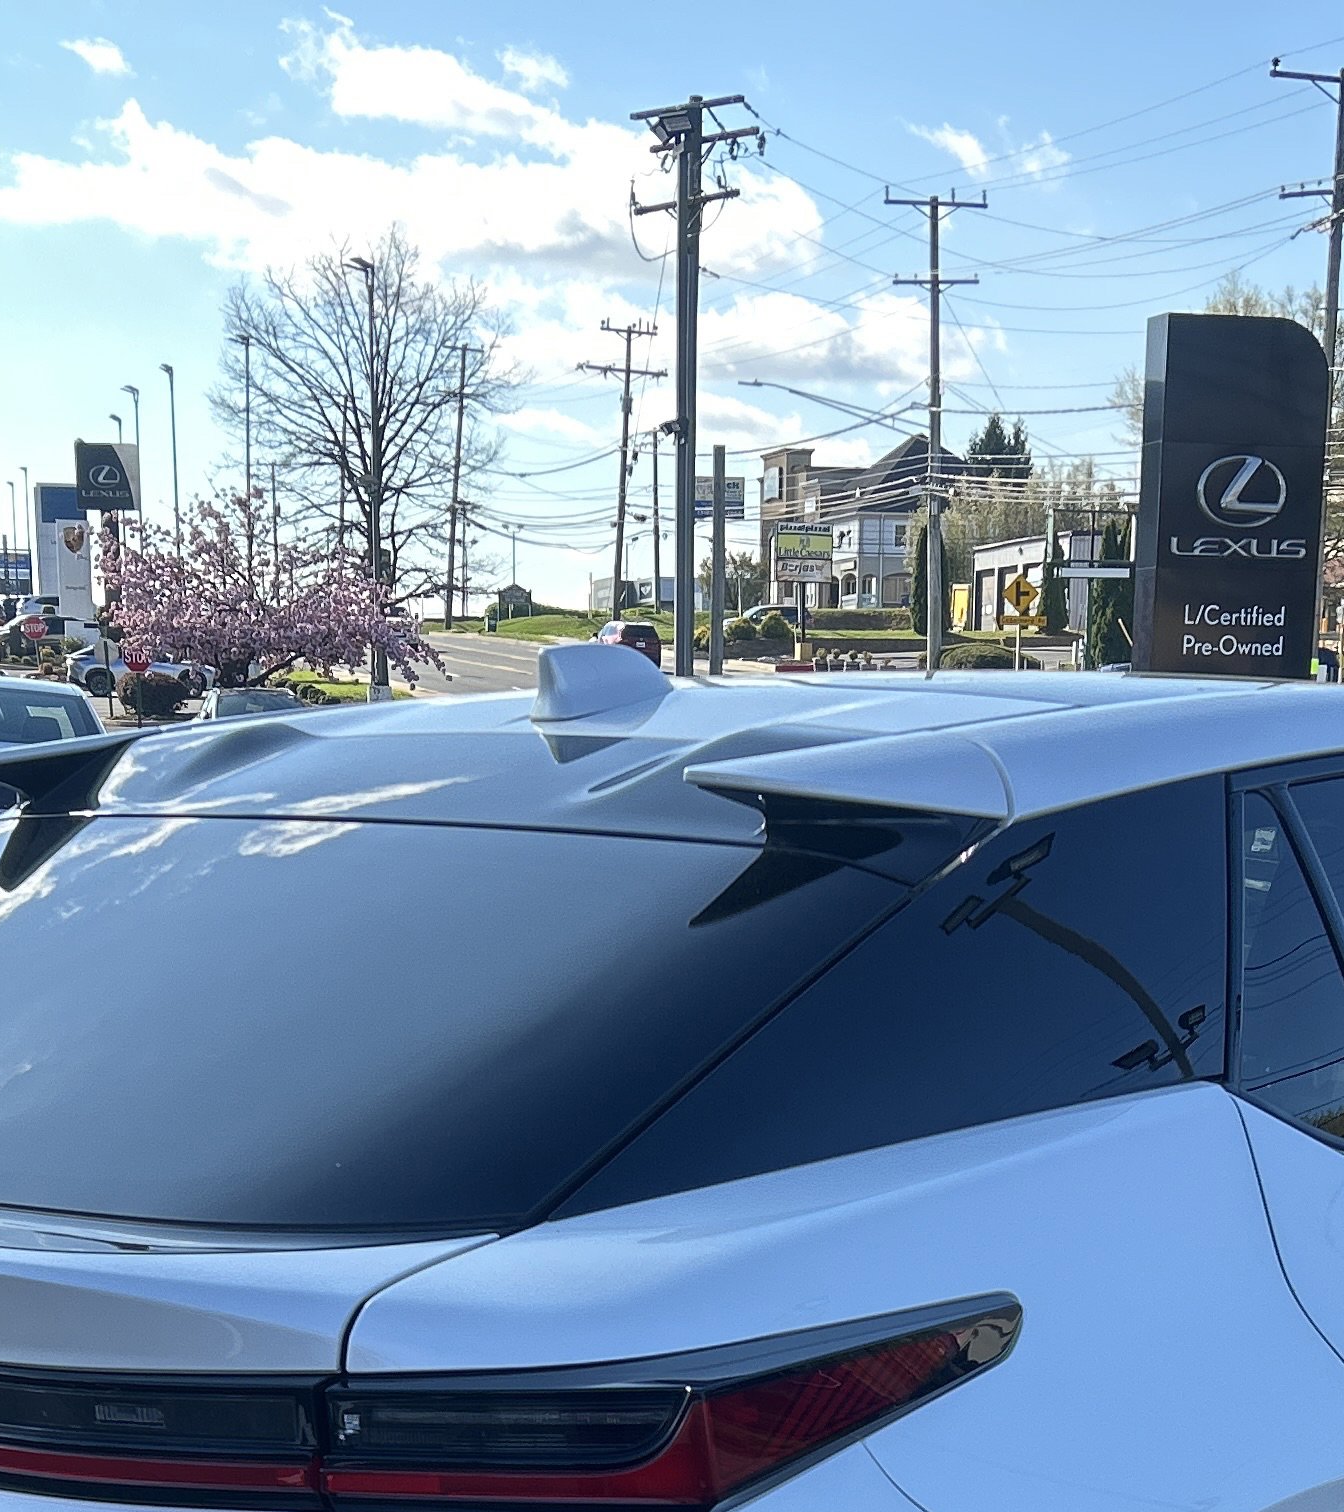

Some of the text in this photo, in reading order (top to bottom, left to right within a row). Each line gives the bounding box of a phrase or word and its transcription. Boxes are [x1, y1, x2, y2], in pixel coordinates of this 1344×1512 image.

[1170, 537, 1307, 559] LEXUS
[1184, 603, 1286, 627] L/Certified
[24, 623, 45, 634] STOP
[1182, 634, 1284, 657] Pre-Owned
